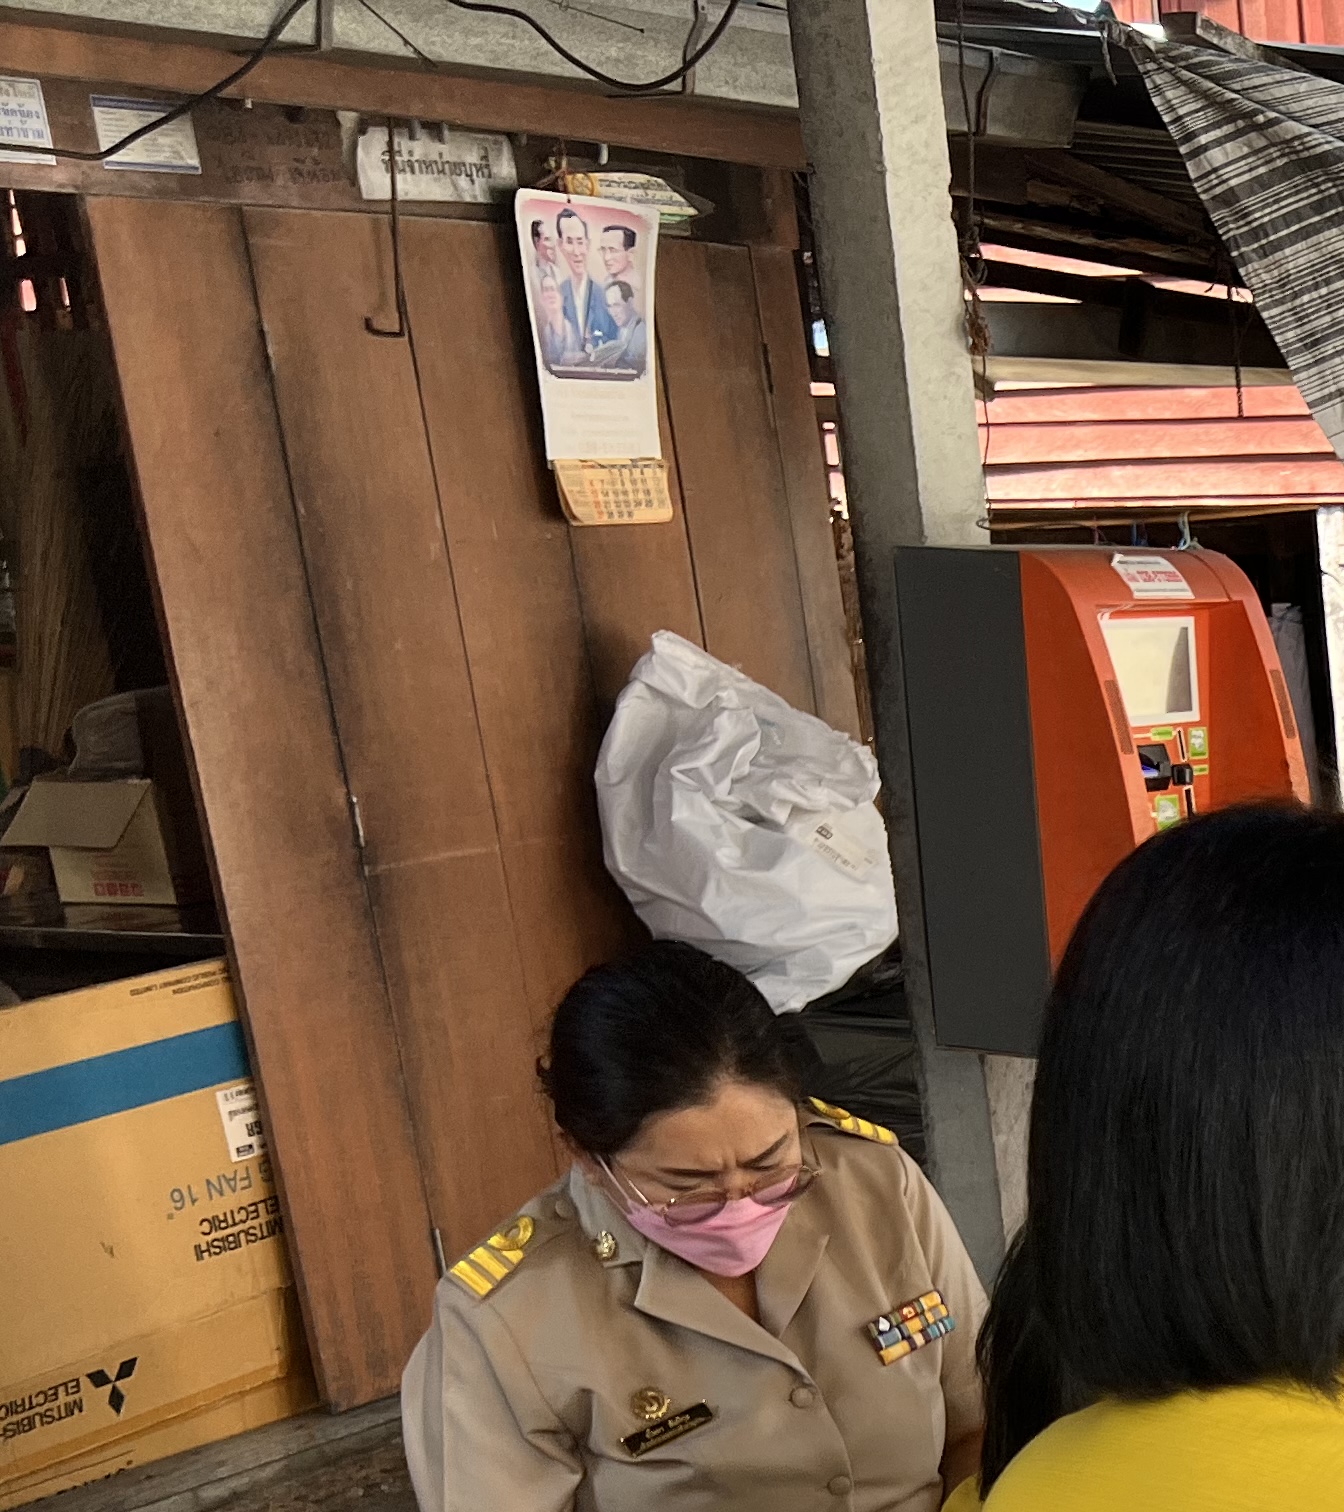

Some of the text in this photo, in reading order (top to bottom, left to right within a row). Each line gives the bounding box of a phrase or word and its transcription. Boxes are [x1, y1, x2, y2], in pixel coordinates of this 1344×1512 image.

[205, 1164, 254, 1201] FAN
[199, 1193, 281, 1237] ELECTRIC
[193, 1215, 285, 1263] MITSUBISHI
[0, 1396, 84, 1441] MITSUBIS
